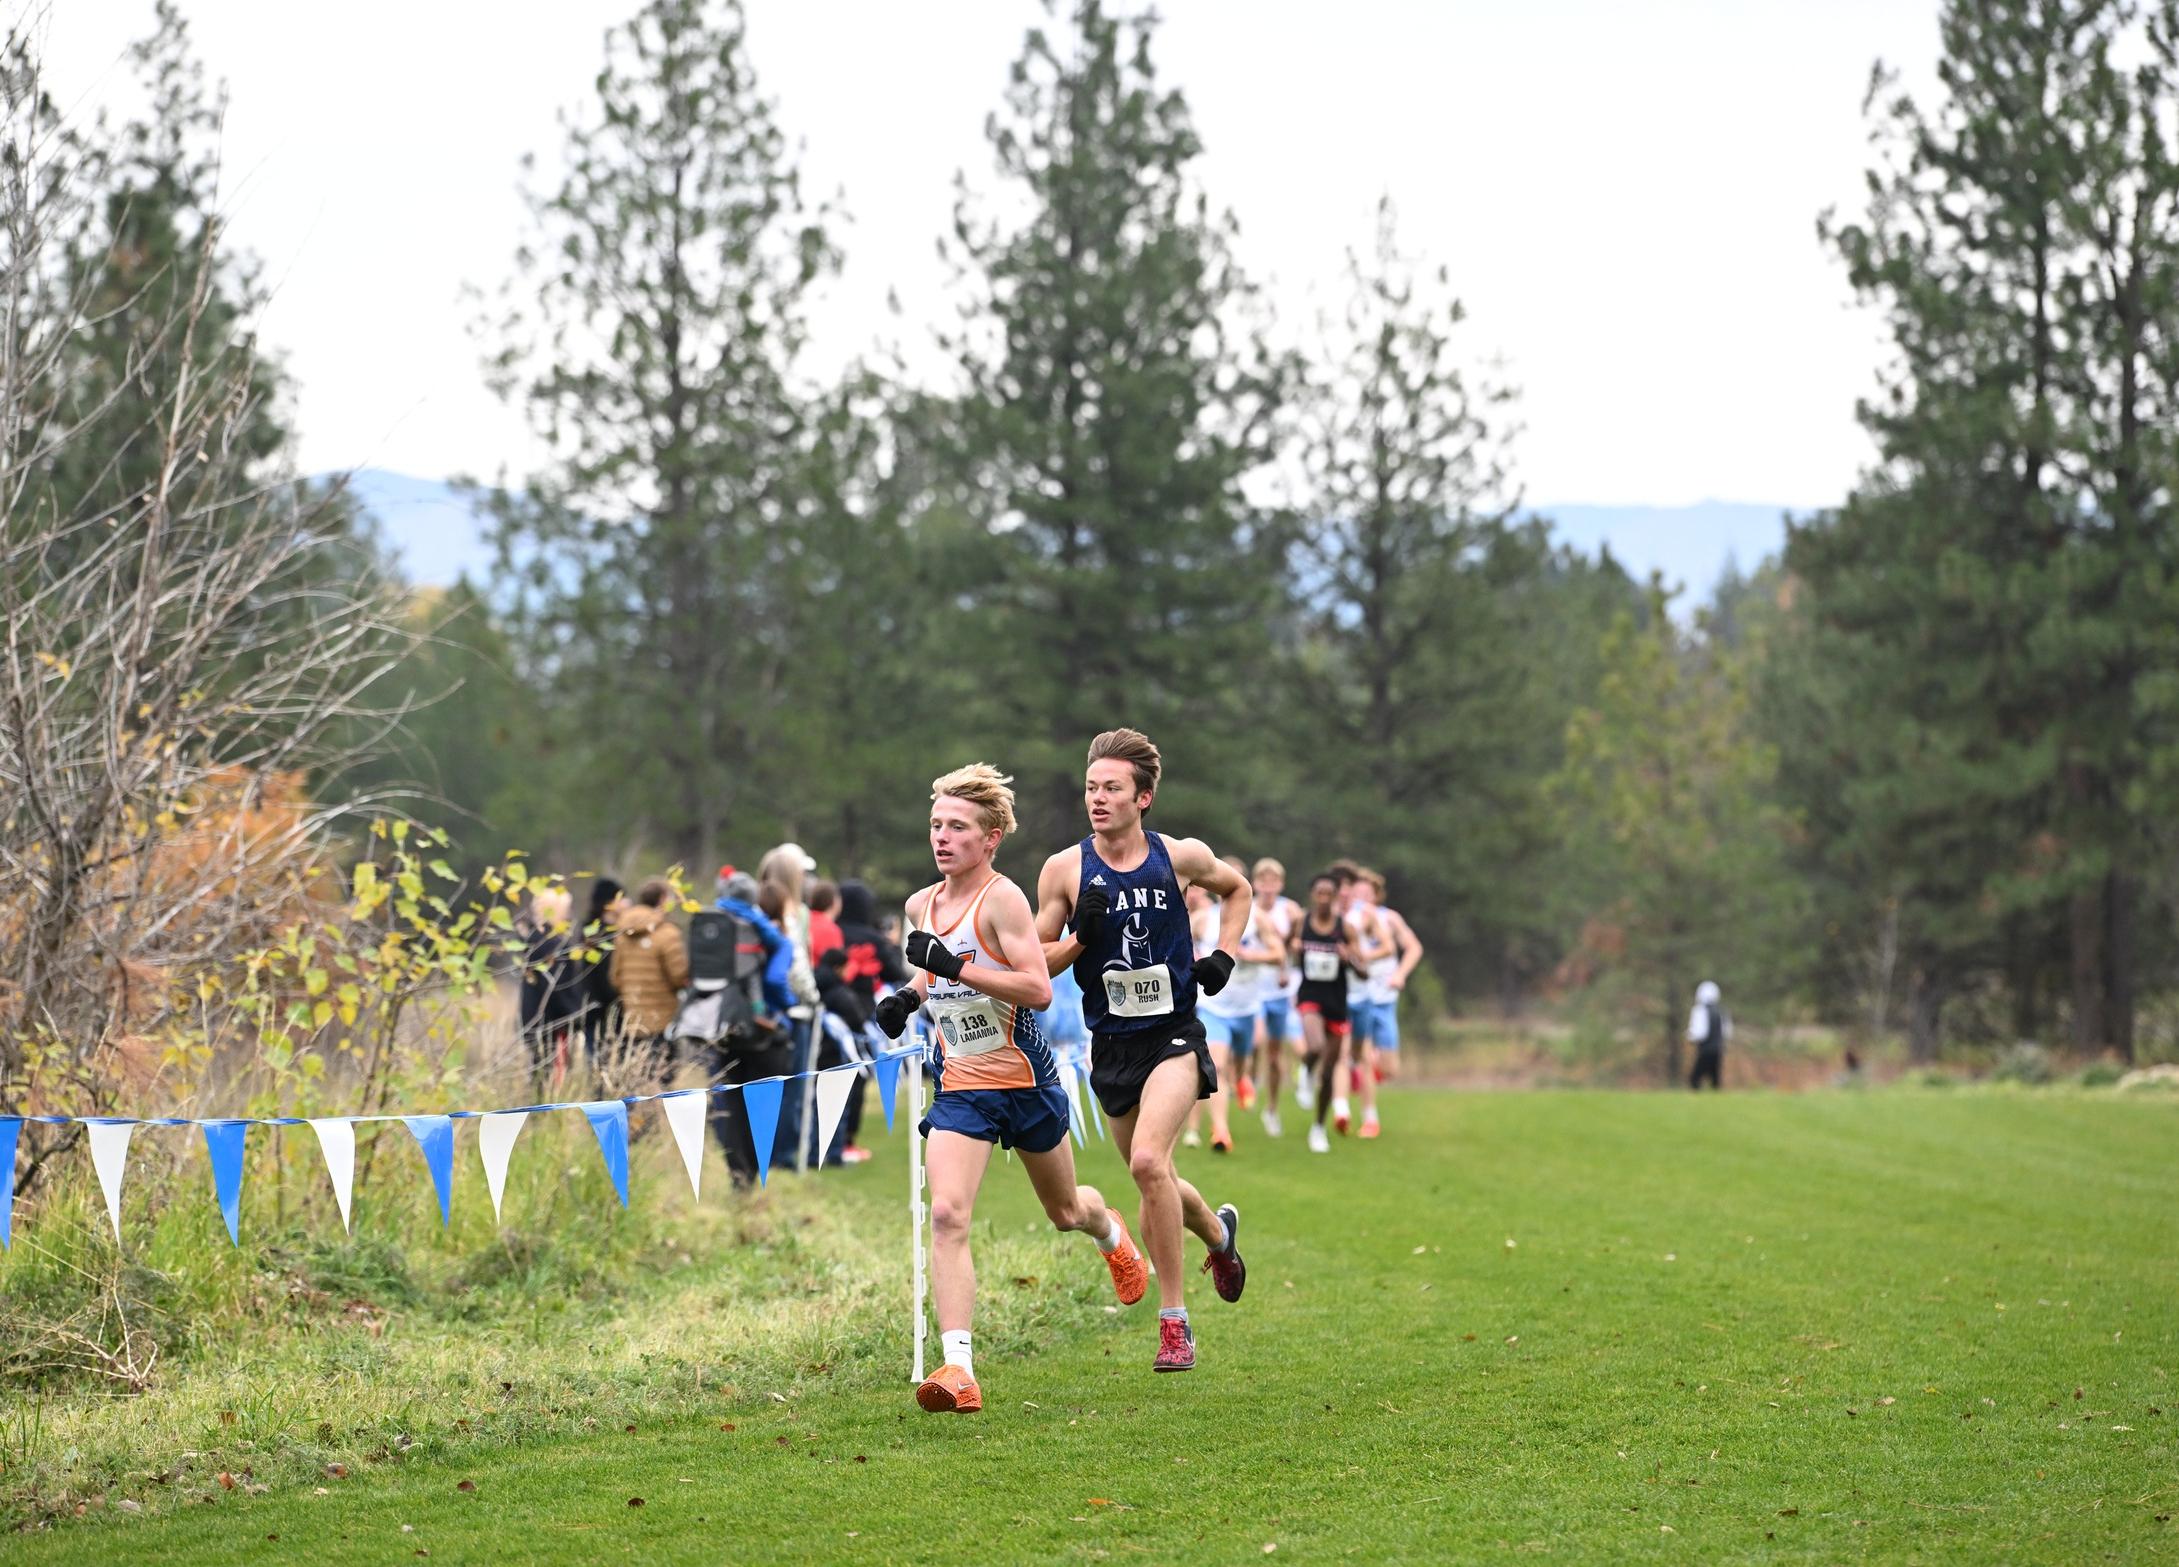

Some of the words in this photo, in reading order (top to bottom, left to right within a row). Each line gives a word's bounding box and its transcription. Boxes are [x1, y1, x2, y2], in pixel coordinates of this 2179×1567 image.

[1106, 887, 1167, 914] ANE
[1134, 979, 1160, 995] 070
[1138, 994, 1159, 1004] RUSH
[961, 1014, 988, 1031] 138
[960, 1026, 999, 1043] LAMANNA
